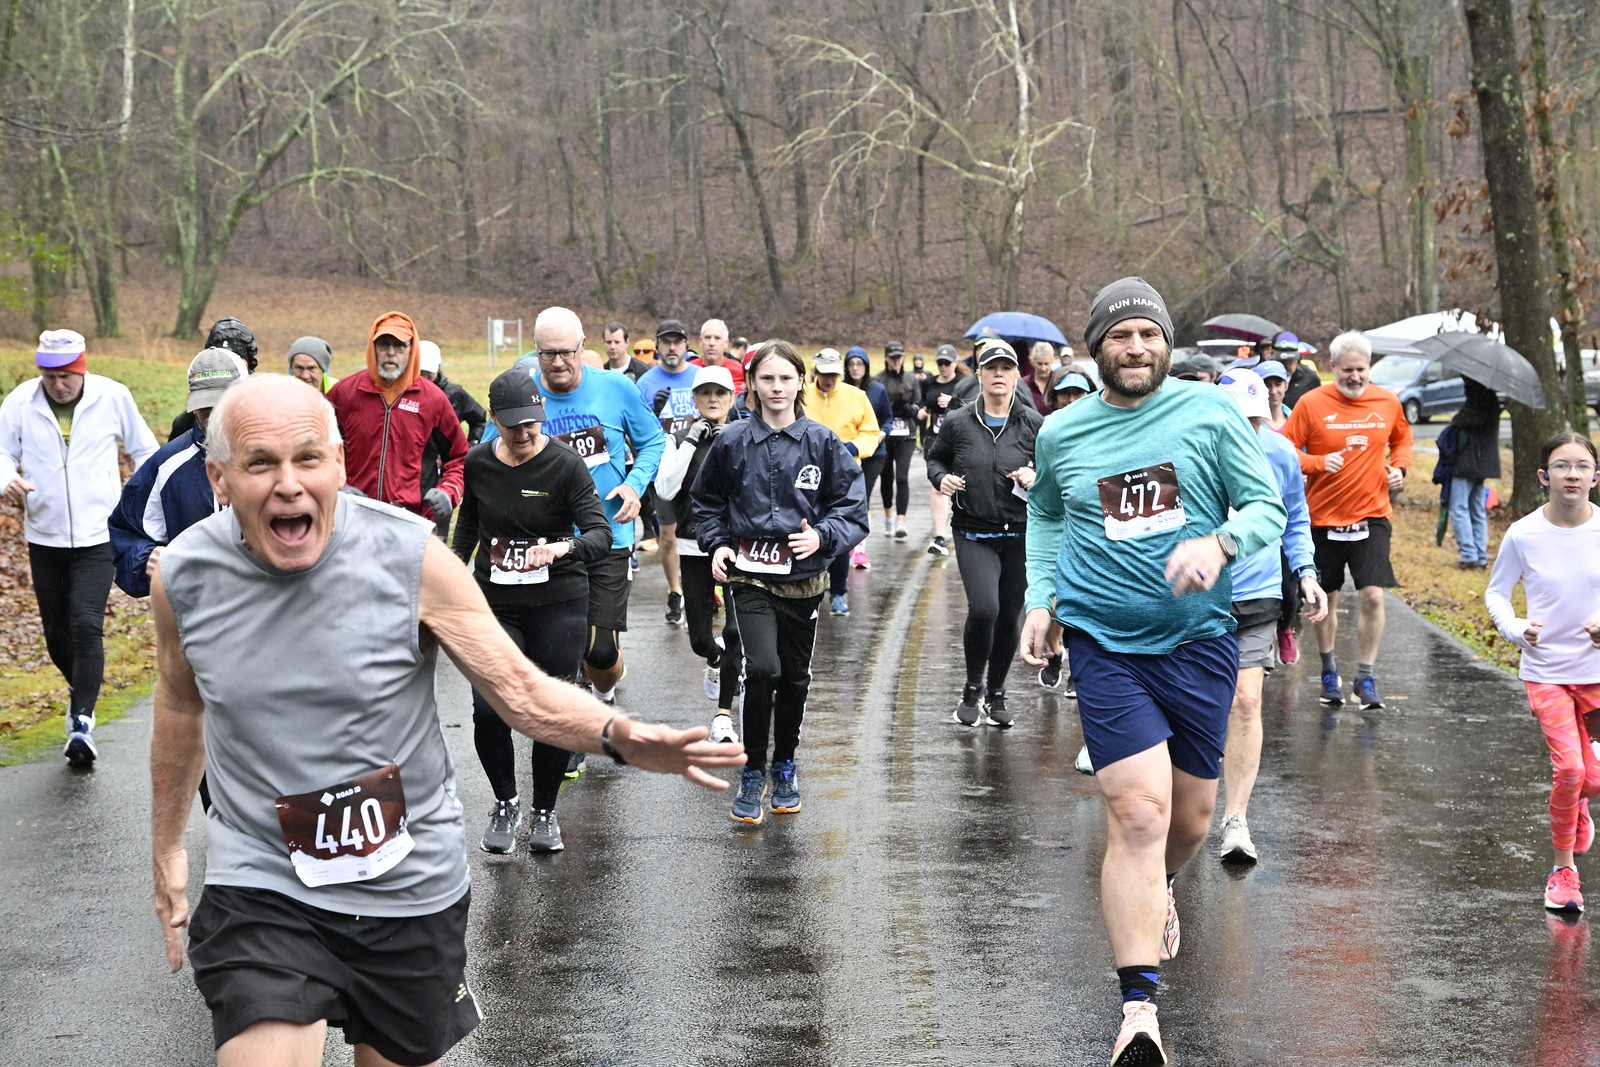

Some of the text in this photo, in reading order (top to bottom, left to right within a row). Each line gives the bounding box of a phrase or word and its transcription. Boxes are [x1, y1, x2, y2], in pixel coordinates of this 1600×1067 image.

[1109, 298, 1161, 313] RUN HAPPY
[672, 391, 690, 404] RUN
[1120, 480, 1165, 516] 472
[749, 541, 780, 563] 446
[336, 788, 353, 800] ROAD
[315, 798, 386, 854] 440
